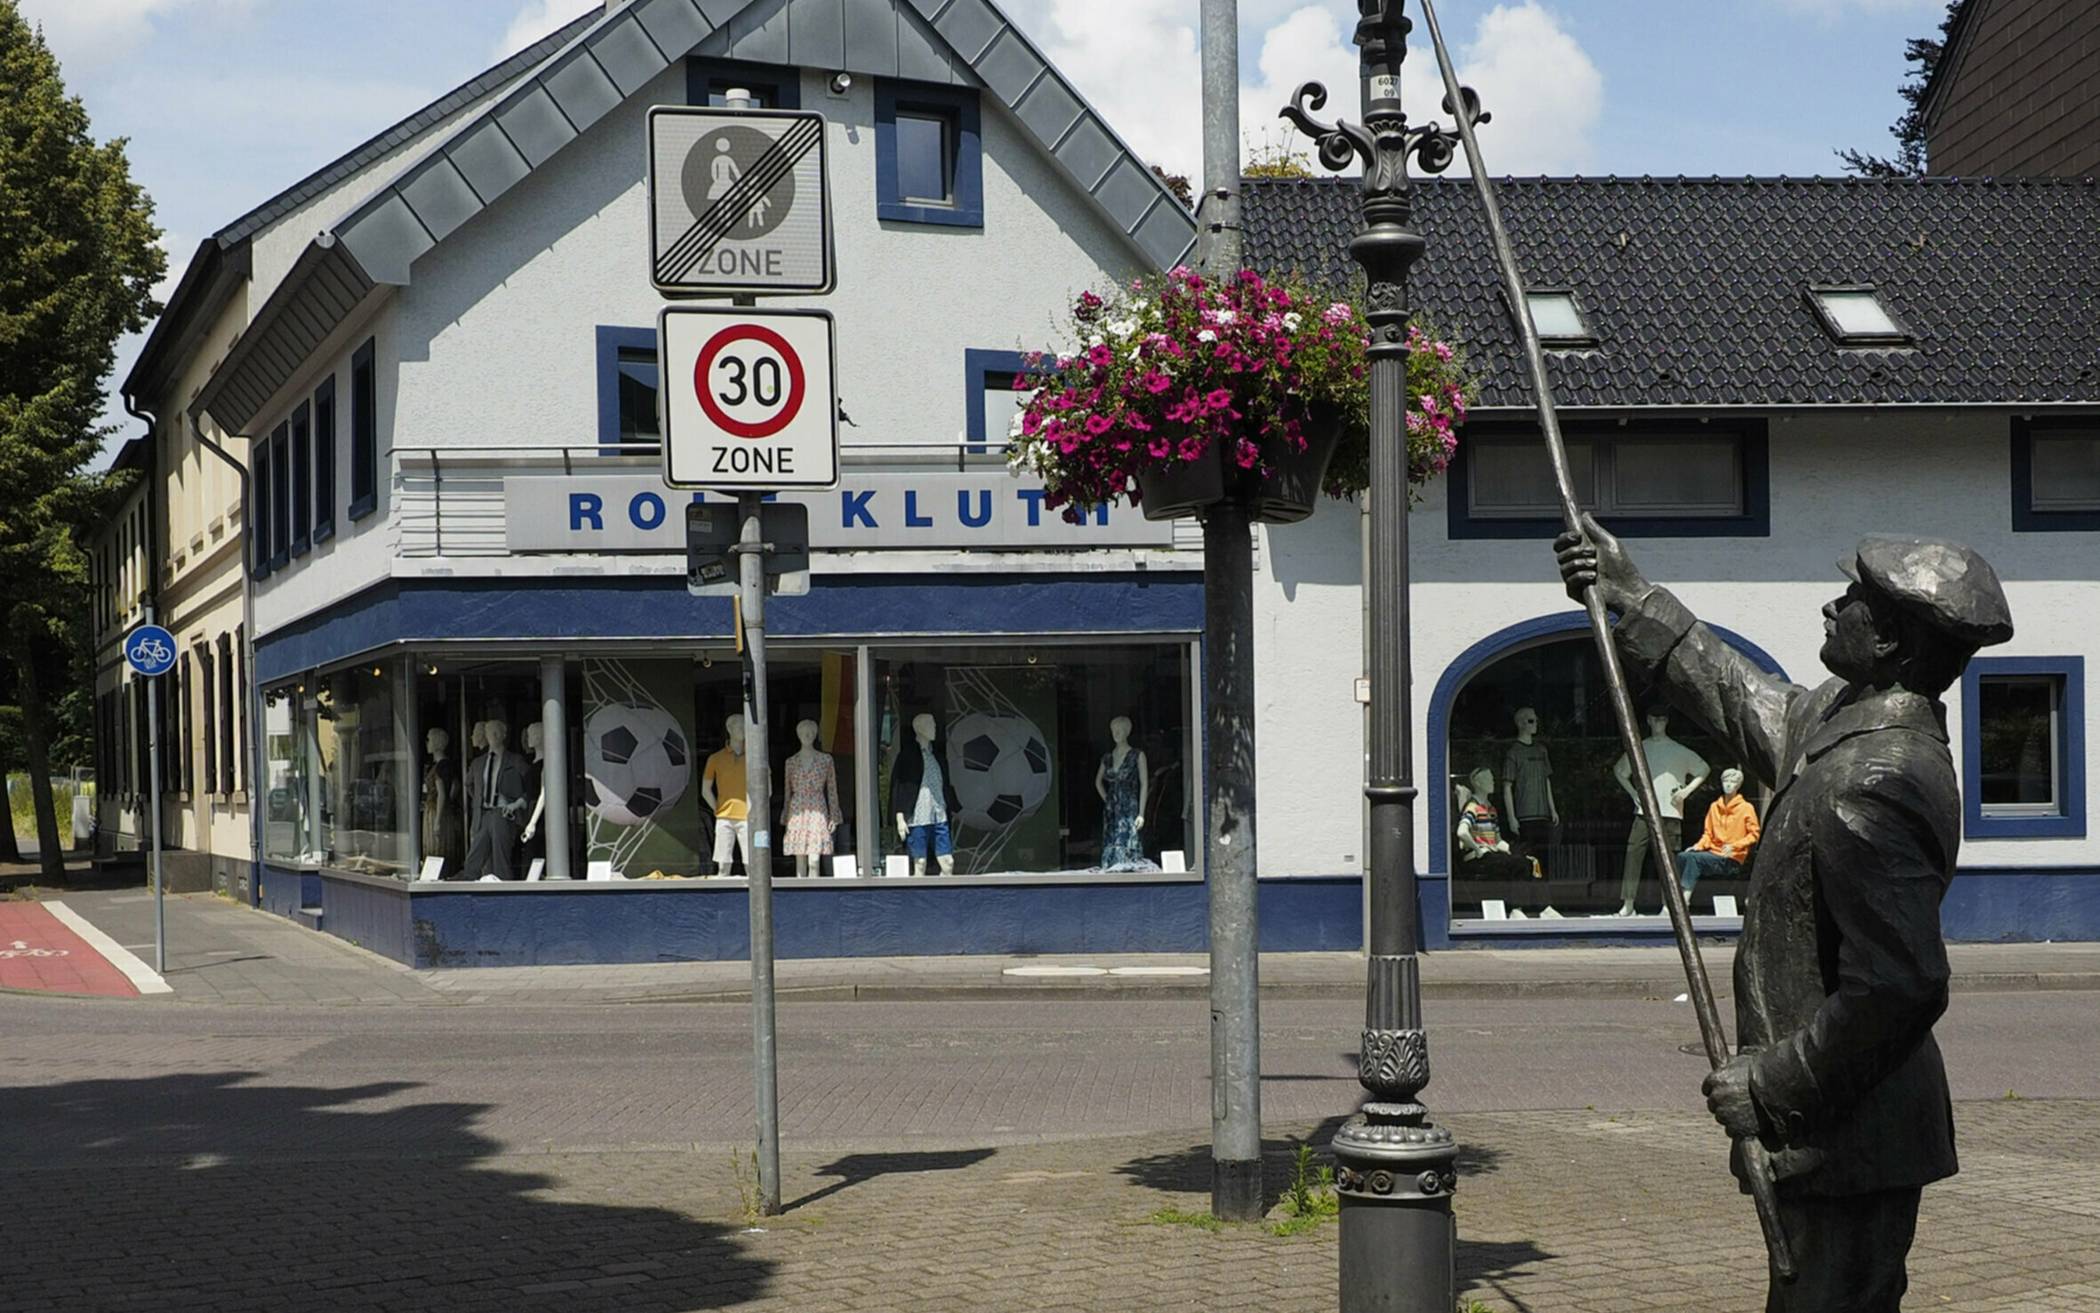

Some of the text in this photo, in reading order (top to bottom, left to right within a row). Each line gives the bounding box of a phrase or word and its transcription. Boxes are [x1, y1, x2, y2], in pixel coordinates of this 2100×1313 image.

[698, 248, 783, 276] ZONE
[718, 356, 782, 407] 30
[711, 447, 795, 474] ZONE
